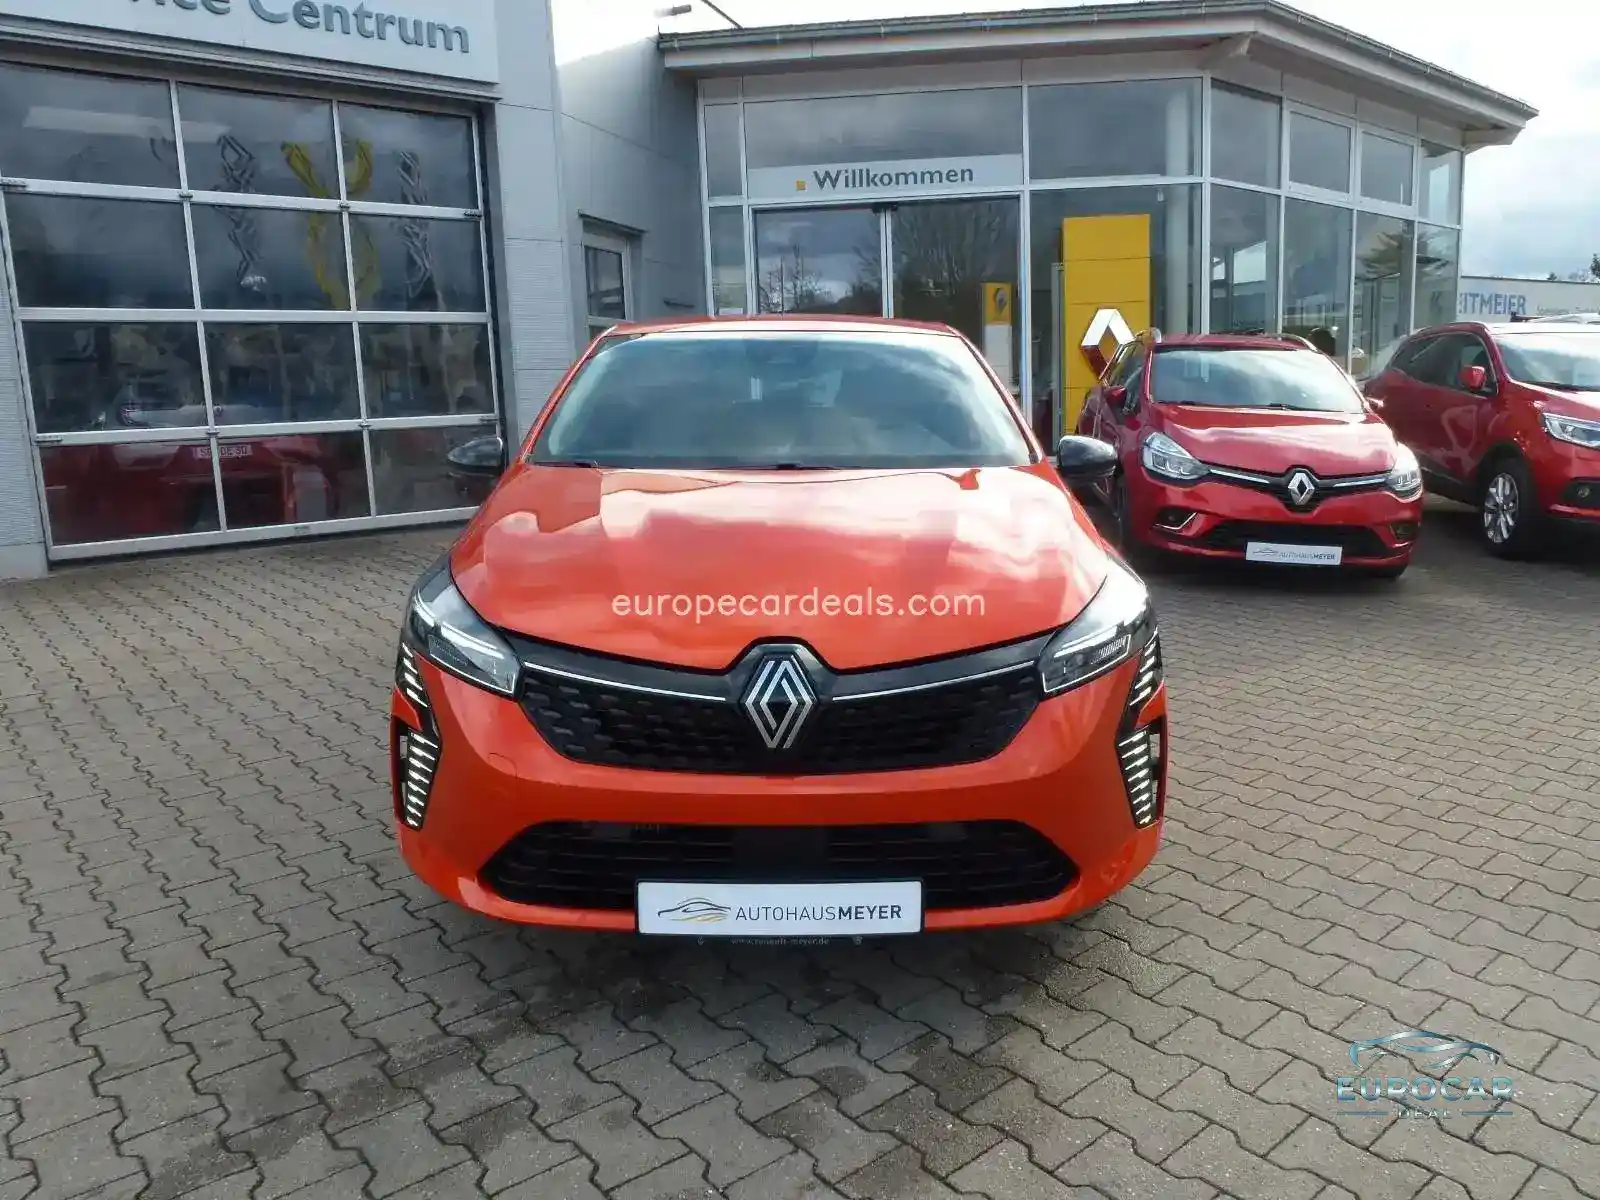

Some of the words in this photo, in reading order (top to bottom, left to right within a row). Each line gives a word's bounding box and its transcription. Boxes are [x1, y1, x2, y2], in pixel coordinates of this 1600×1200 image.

[249, 0, 470, 53] Centrum
[813, 167, 974, 190] Willkommen
[735, 905, 902, 921] AUTOHAUSMEYER
